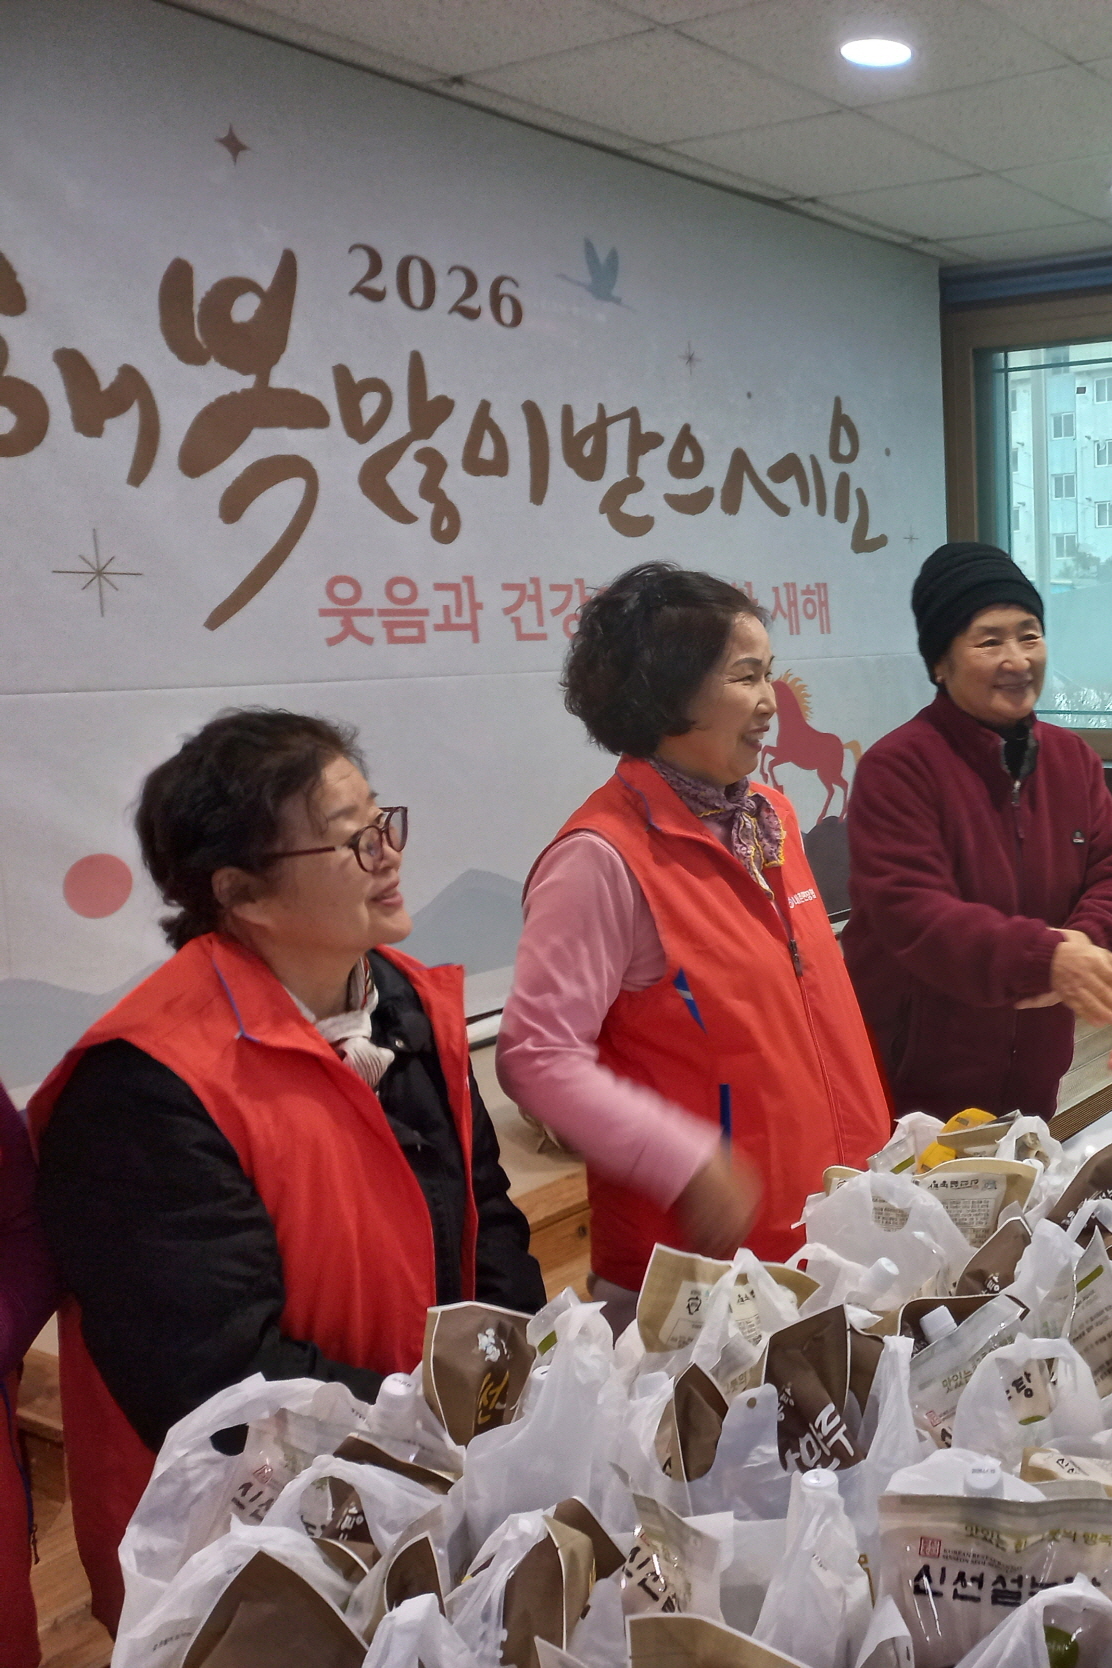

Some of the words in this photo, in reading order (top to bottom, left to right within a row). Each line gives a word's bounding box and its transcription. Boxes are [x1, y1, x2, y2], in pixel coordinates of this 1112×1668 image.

[349, 242, 524, 329] 2026
[160, 248, 330, 632] 복
[333, 350, 550, 545] 많이
[560, 395, 888, 554] 받으세요
[318, 575, 483, 646] 웃음과
[501, 576, 608, 642] 건강
[771, 582, 831, 635] 새해
[1005, 1371, 1034, 1401] 탕
[912, 1563, 1103, 1607] 신선설
